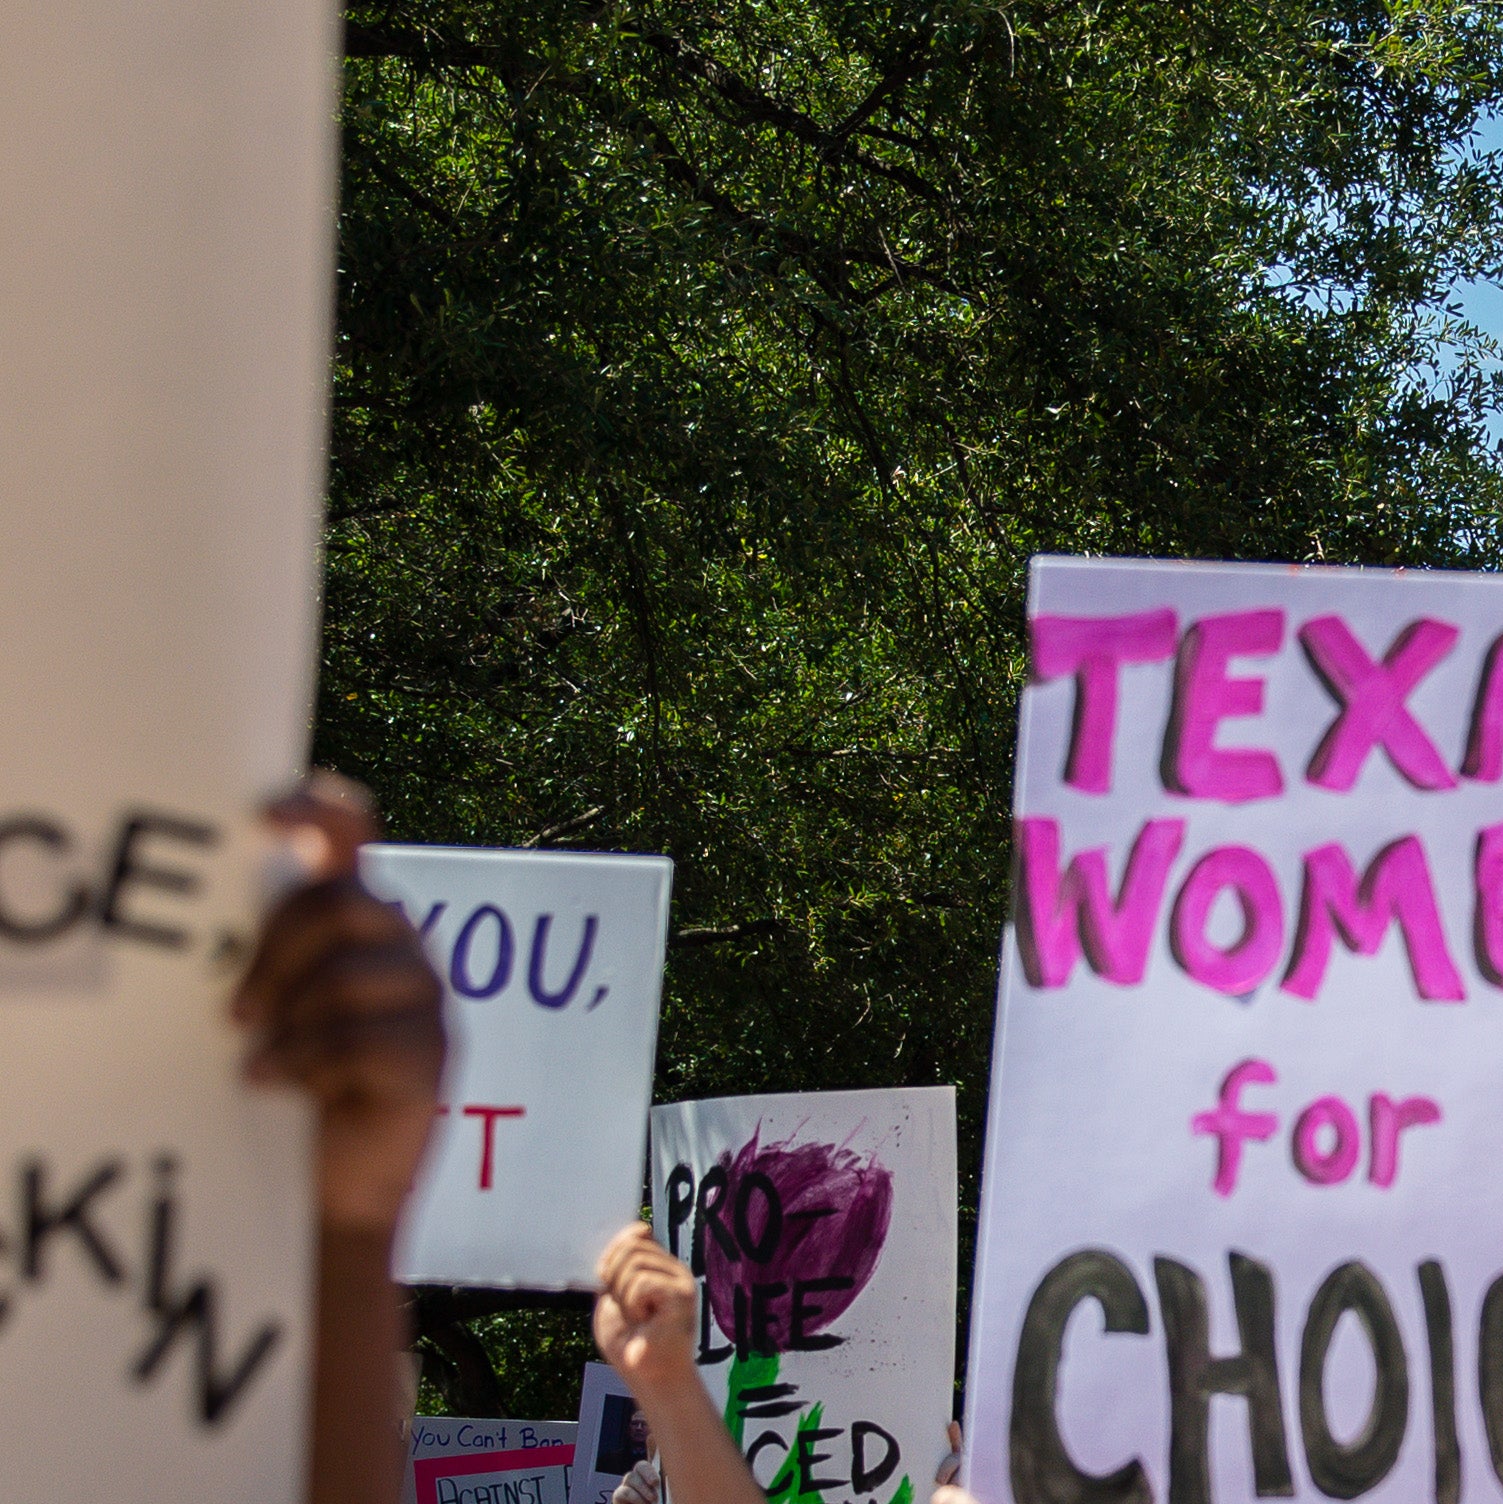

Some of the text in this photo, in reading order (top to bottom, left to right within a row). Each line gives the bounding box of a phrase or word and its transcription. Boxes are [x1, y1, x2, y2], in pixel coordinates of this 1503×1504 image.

[441, 1104, 526, 1190] T
[1193, 1059, 1442, 1197] for
[697, 1277, 856, 1365] LIFE
[746, 1420, 901, 1498] CED
